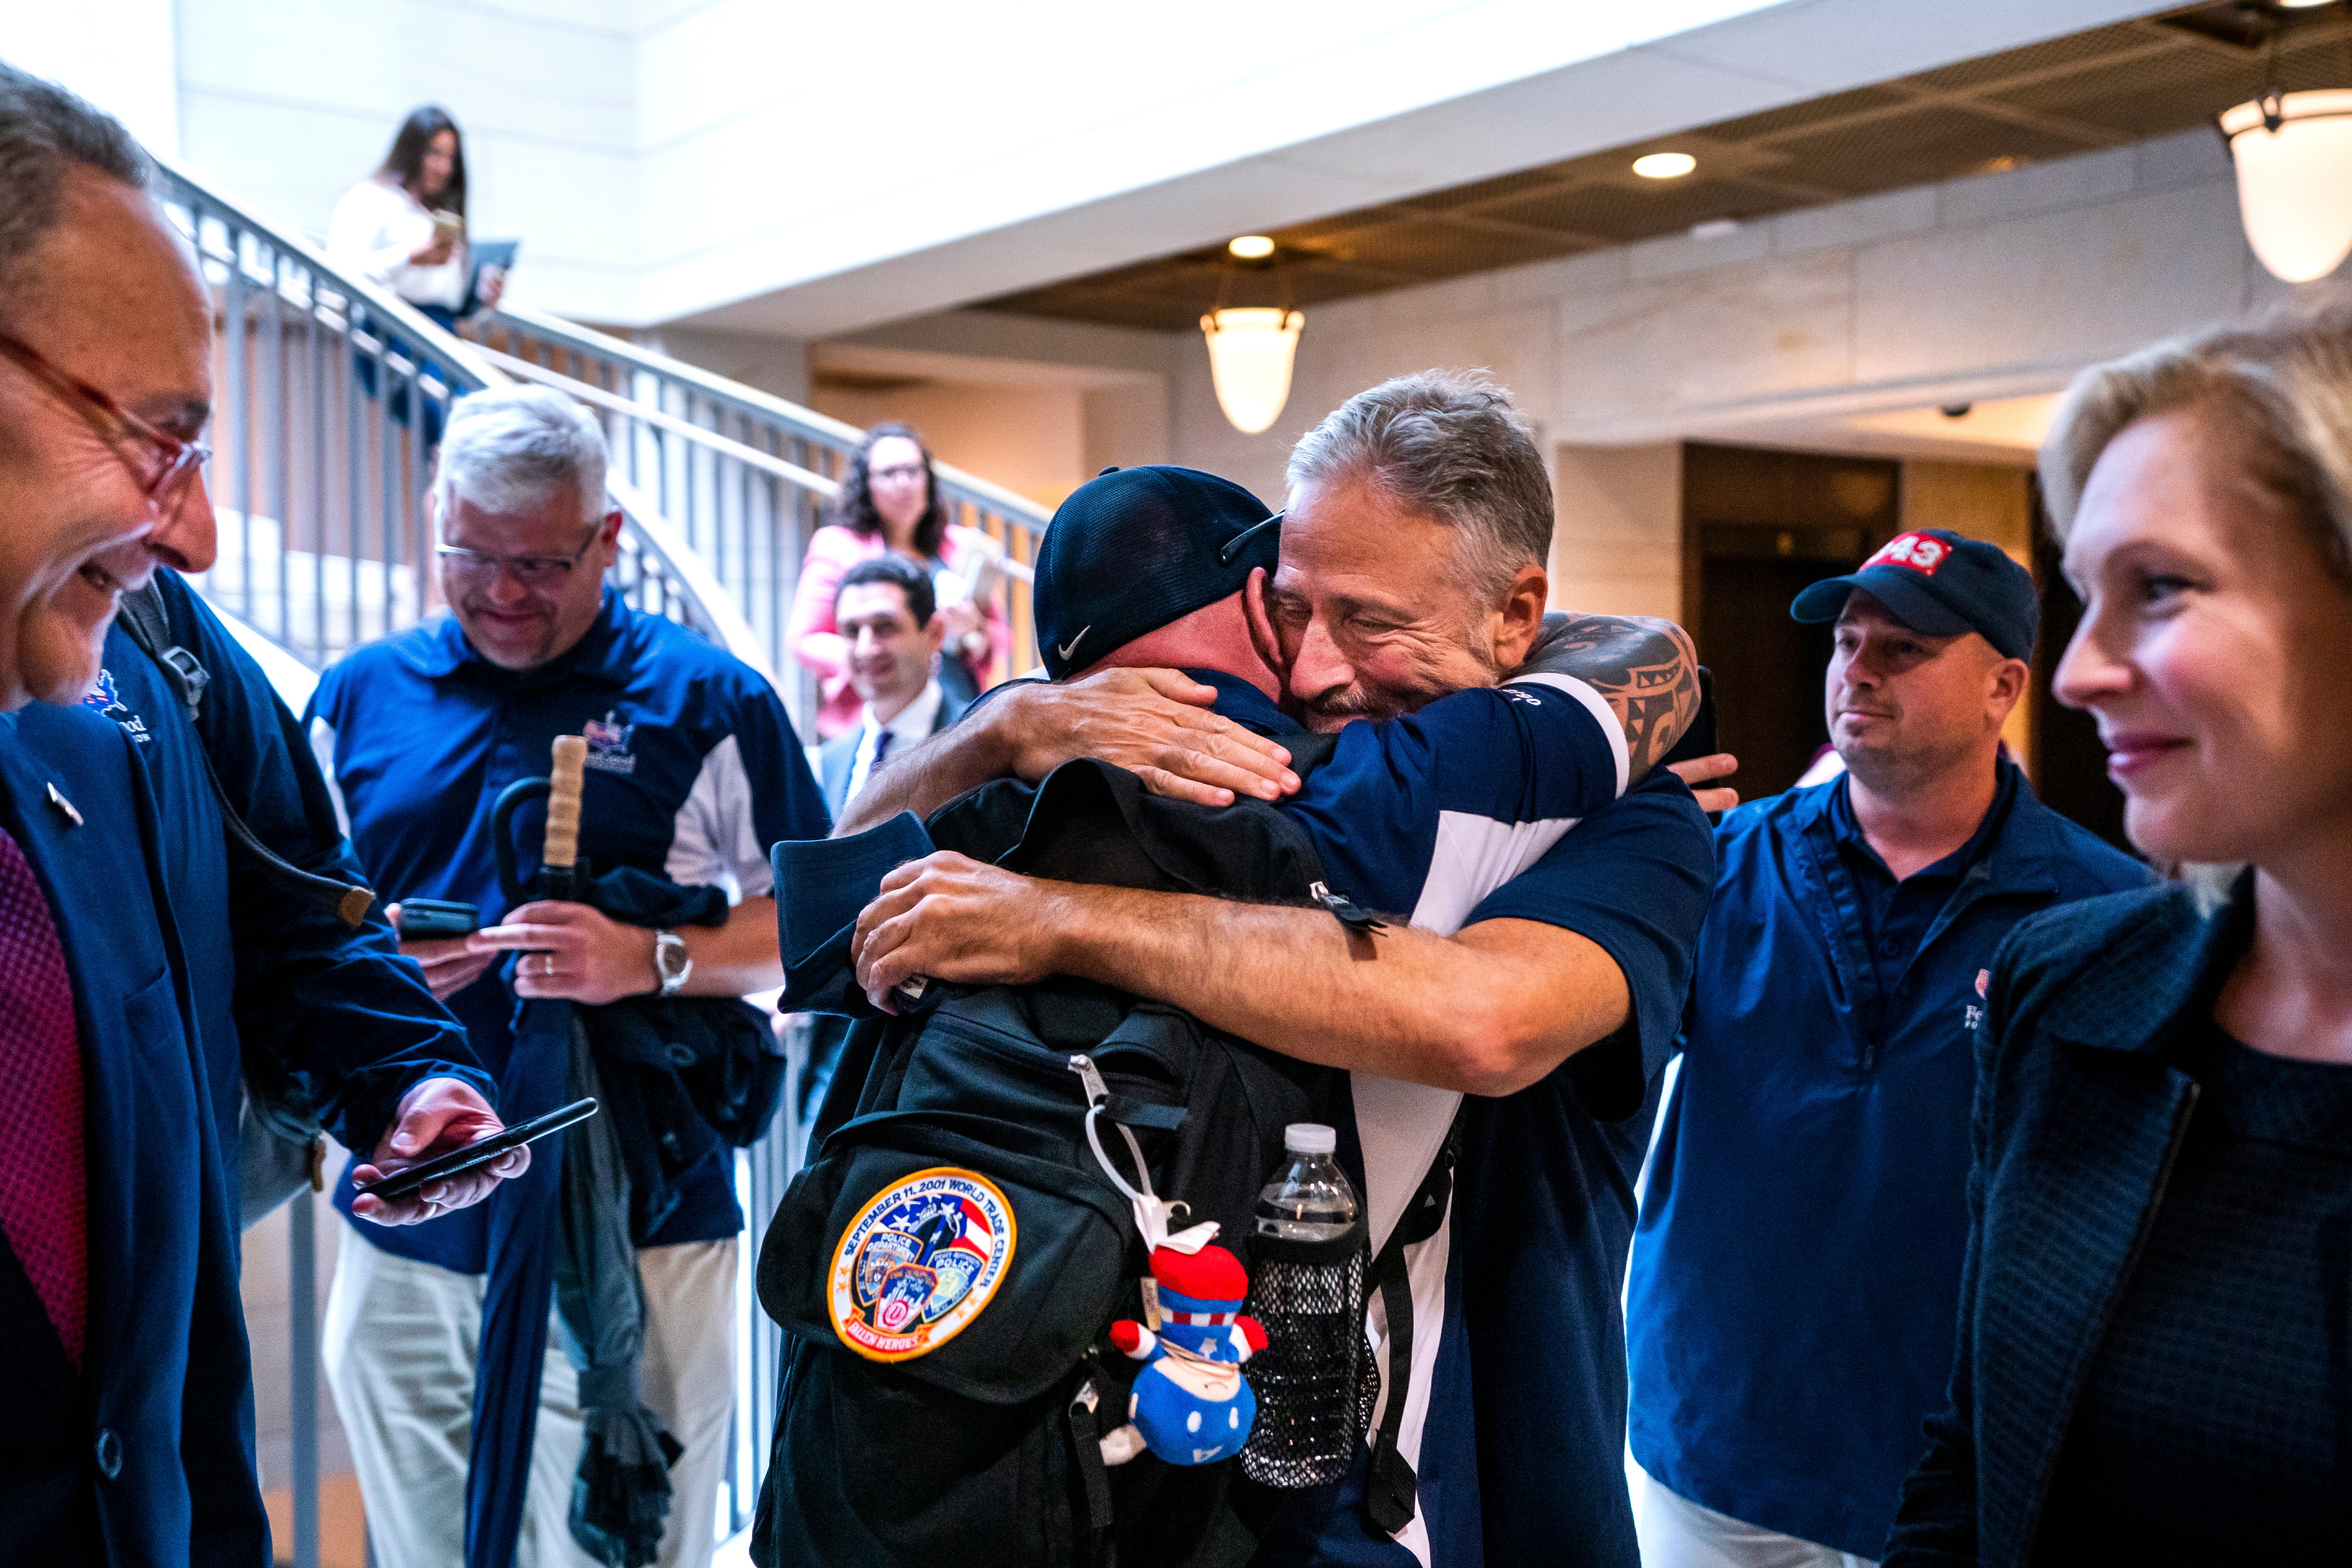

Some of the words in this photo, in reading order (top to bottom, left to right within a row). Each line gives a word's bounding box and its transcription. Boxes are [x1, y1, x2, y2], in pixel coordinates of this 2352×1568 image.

[918, 1179, 946, 1192] 2001
[949, 1179, 985, 1202] WORLD
[844, 1192, 901, 1256] SEPTEMBER
[983, 1199, 1004, 1236] TRADE
[881, 1233, 912, 1248] POLICE
[936, 1258, 975, 1276] POLICE
[980, 1240, 1005, 1288] CENTER
